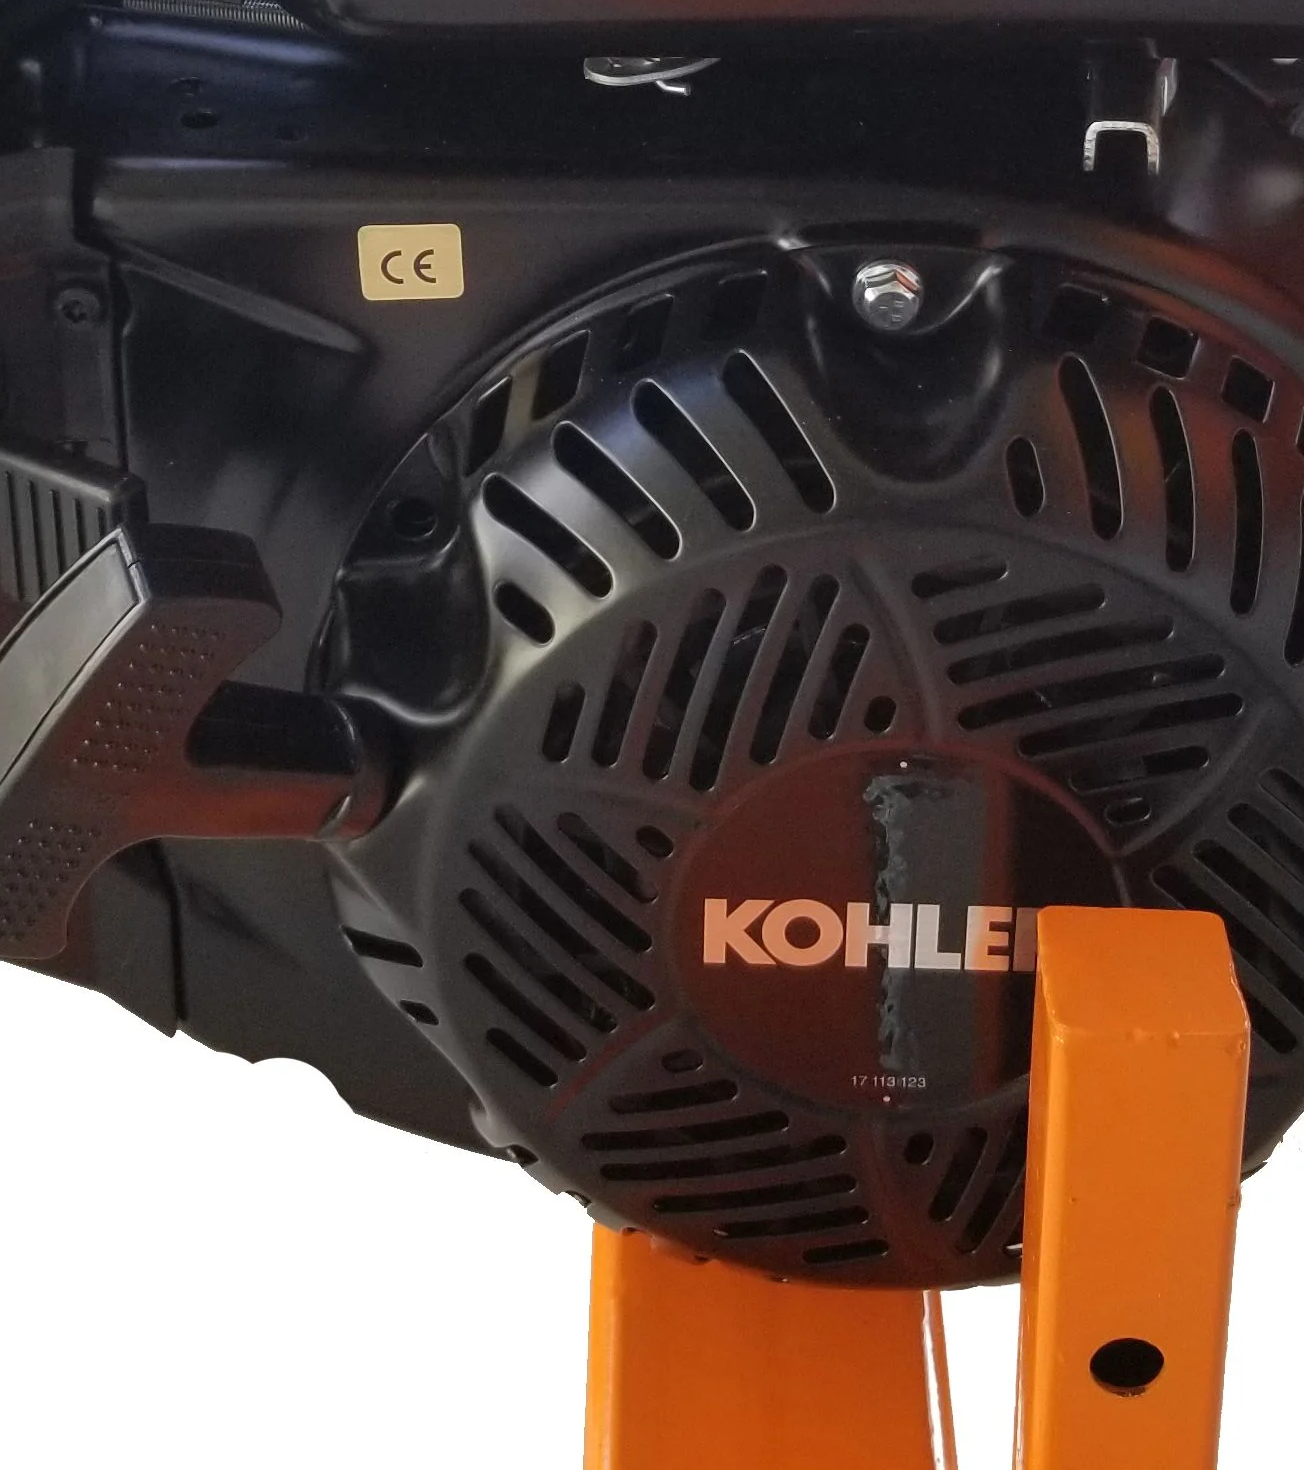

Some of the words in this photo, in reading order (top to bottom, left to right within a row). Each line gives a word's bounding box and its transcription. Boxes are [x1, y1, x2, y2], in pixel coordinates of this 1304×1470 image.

[381, 249, 437, 284] CE
[851, 1076, 867, 1087] 17
[873, 1076, 896, 1087] 113
[901, 1077, 926, 1088] 123
